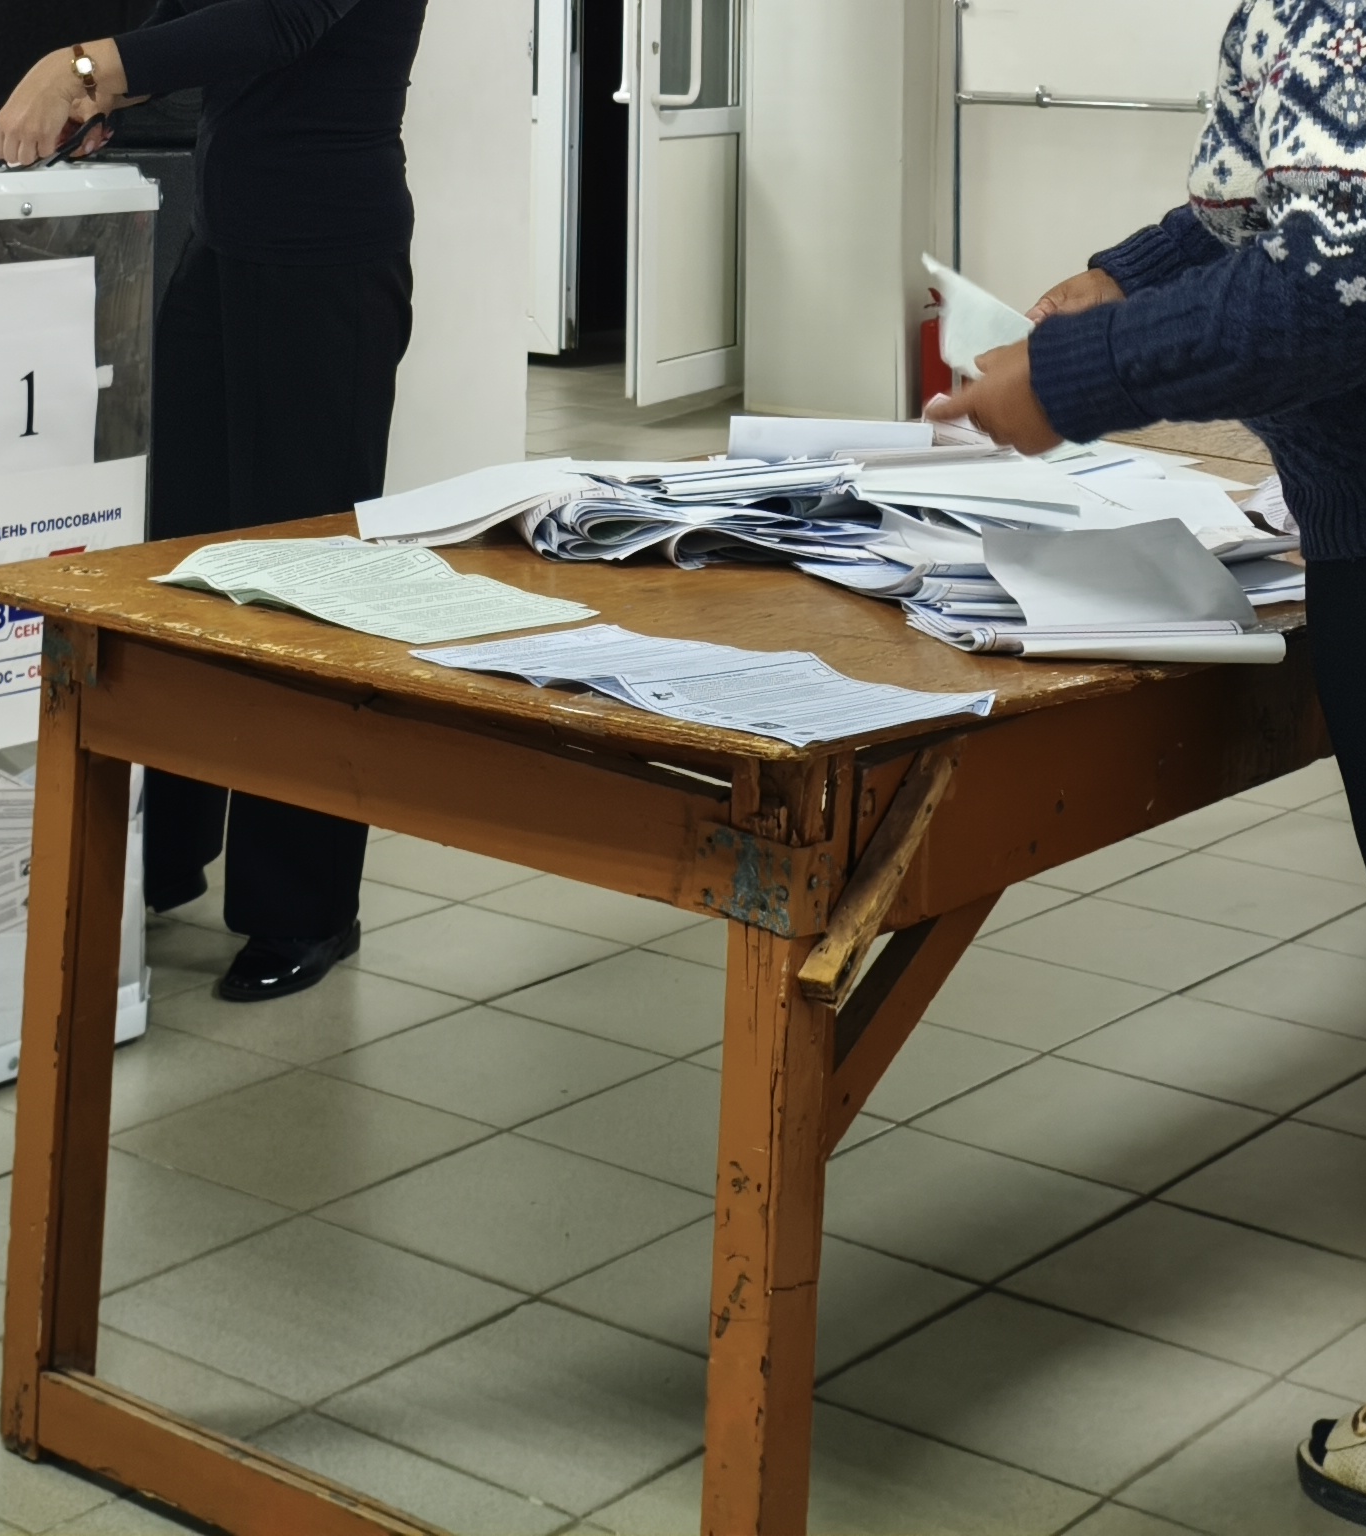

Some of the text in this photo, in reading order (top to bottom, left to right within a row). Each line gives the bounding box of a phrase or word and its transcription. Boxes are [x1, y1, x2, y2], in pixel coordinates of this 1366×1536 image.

[19, 370, 40, 437] 1
[30, 507, 123, 535] ГОЛОСОВАНИЯ
[14, 621, 43, 639] СЕН
